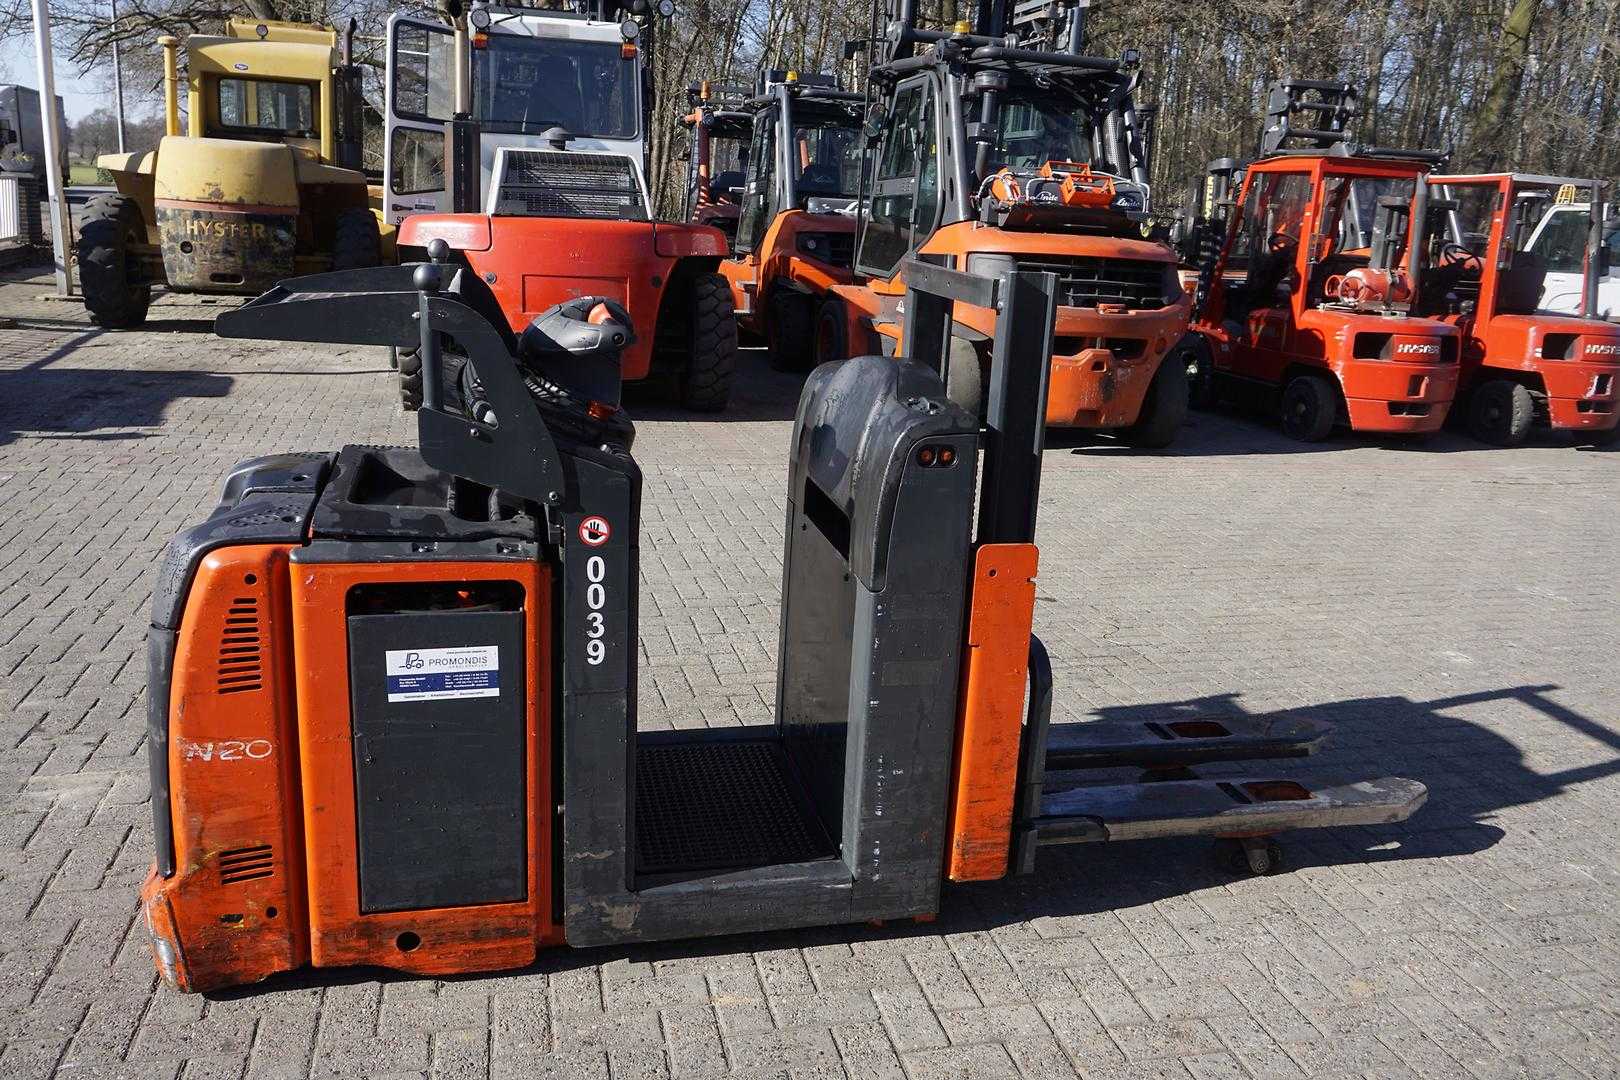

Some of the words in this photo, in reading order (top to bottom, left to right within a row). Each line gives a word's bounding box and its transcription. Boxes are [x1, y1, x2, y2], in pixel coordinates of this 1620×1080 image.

[186, 220, 265, 239] HYSTER
[1397, 344, 1440, 353] HYSTER
[586, 555, 606, 666] 0039
[429, 656, 488, 667] PROMONDIS
